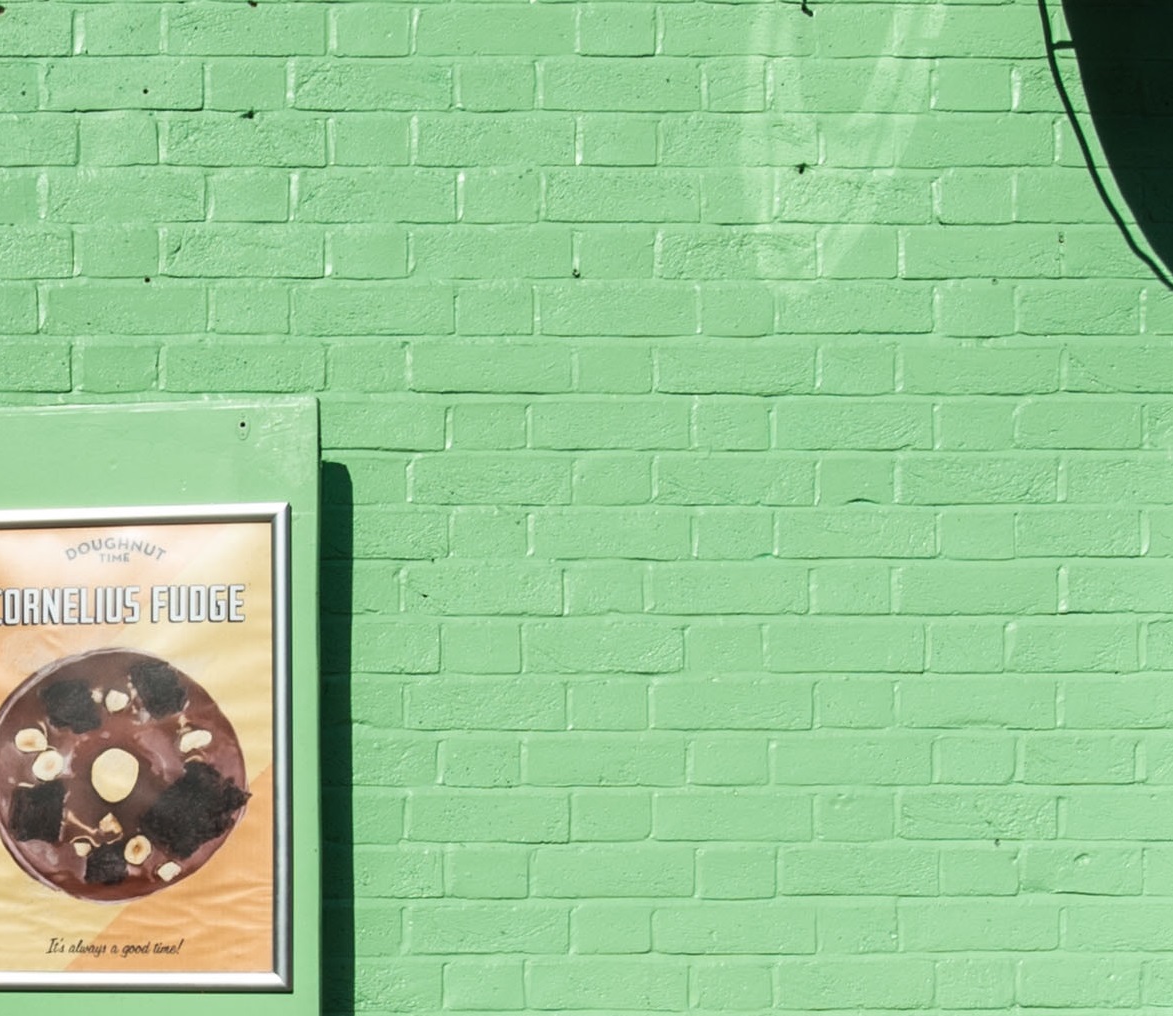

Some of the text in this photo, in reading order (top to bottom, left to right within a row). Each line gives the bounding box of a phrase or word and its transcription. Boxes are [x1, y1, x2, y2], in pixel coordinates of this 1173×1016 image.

[64, 537, 167, 561] DOUGHNUT
[99, 552, 131, 563] TIME
[150, 584, 246, 623] FUDGE
[45, 937, 185, 958] It's always a good time!
